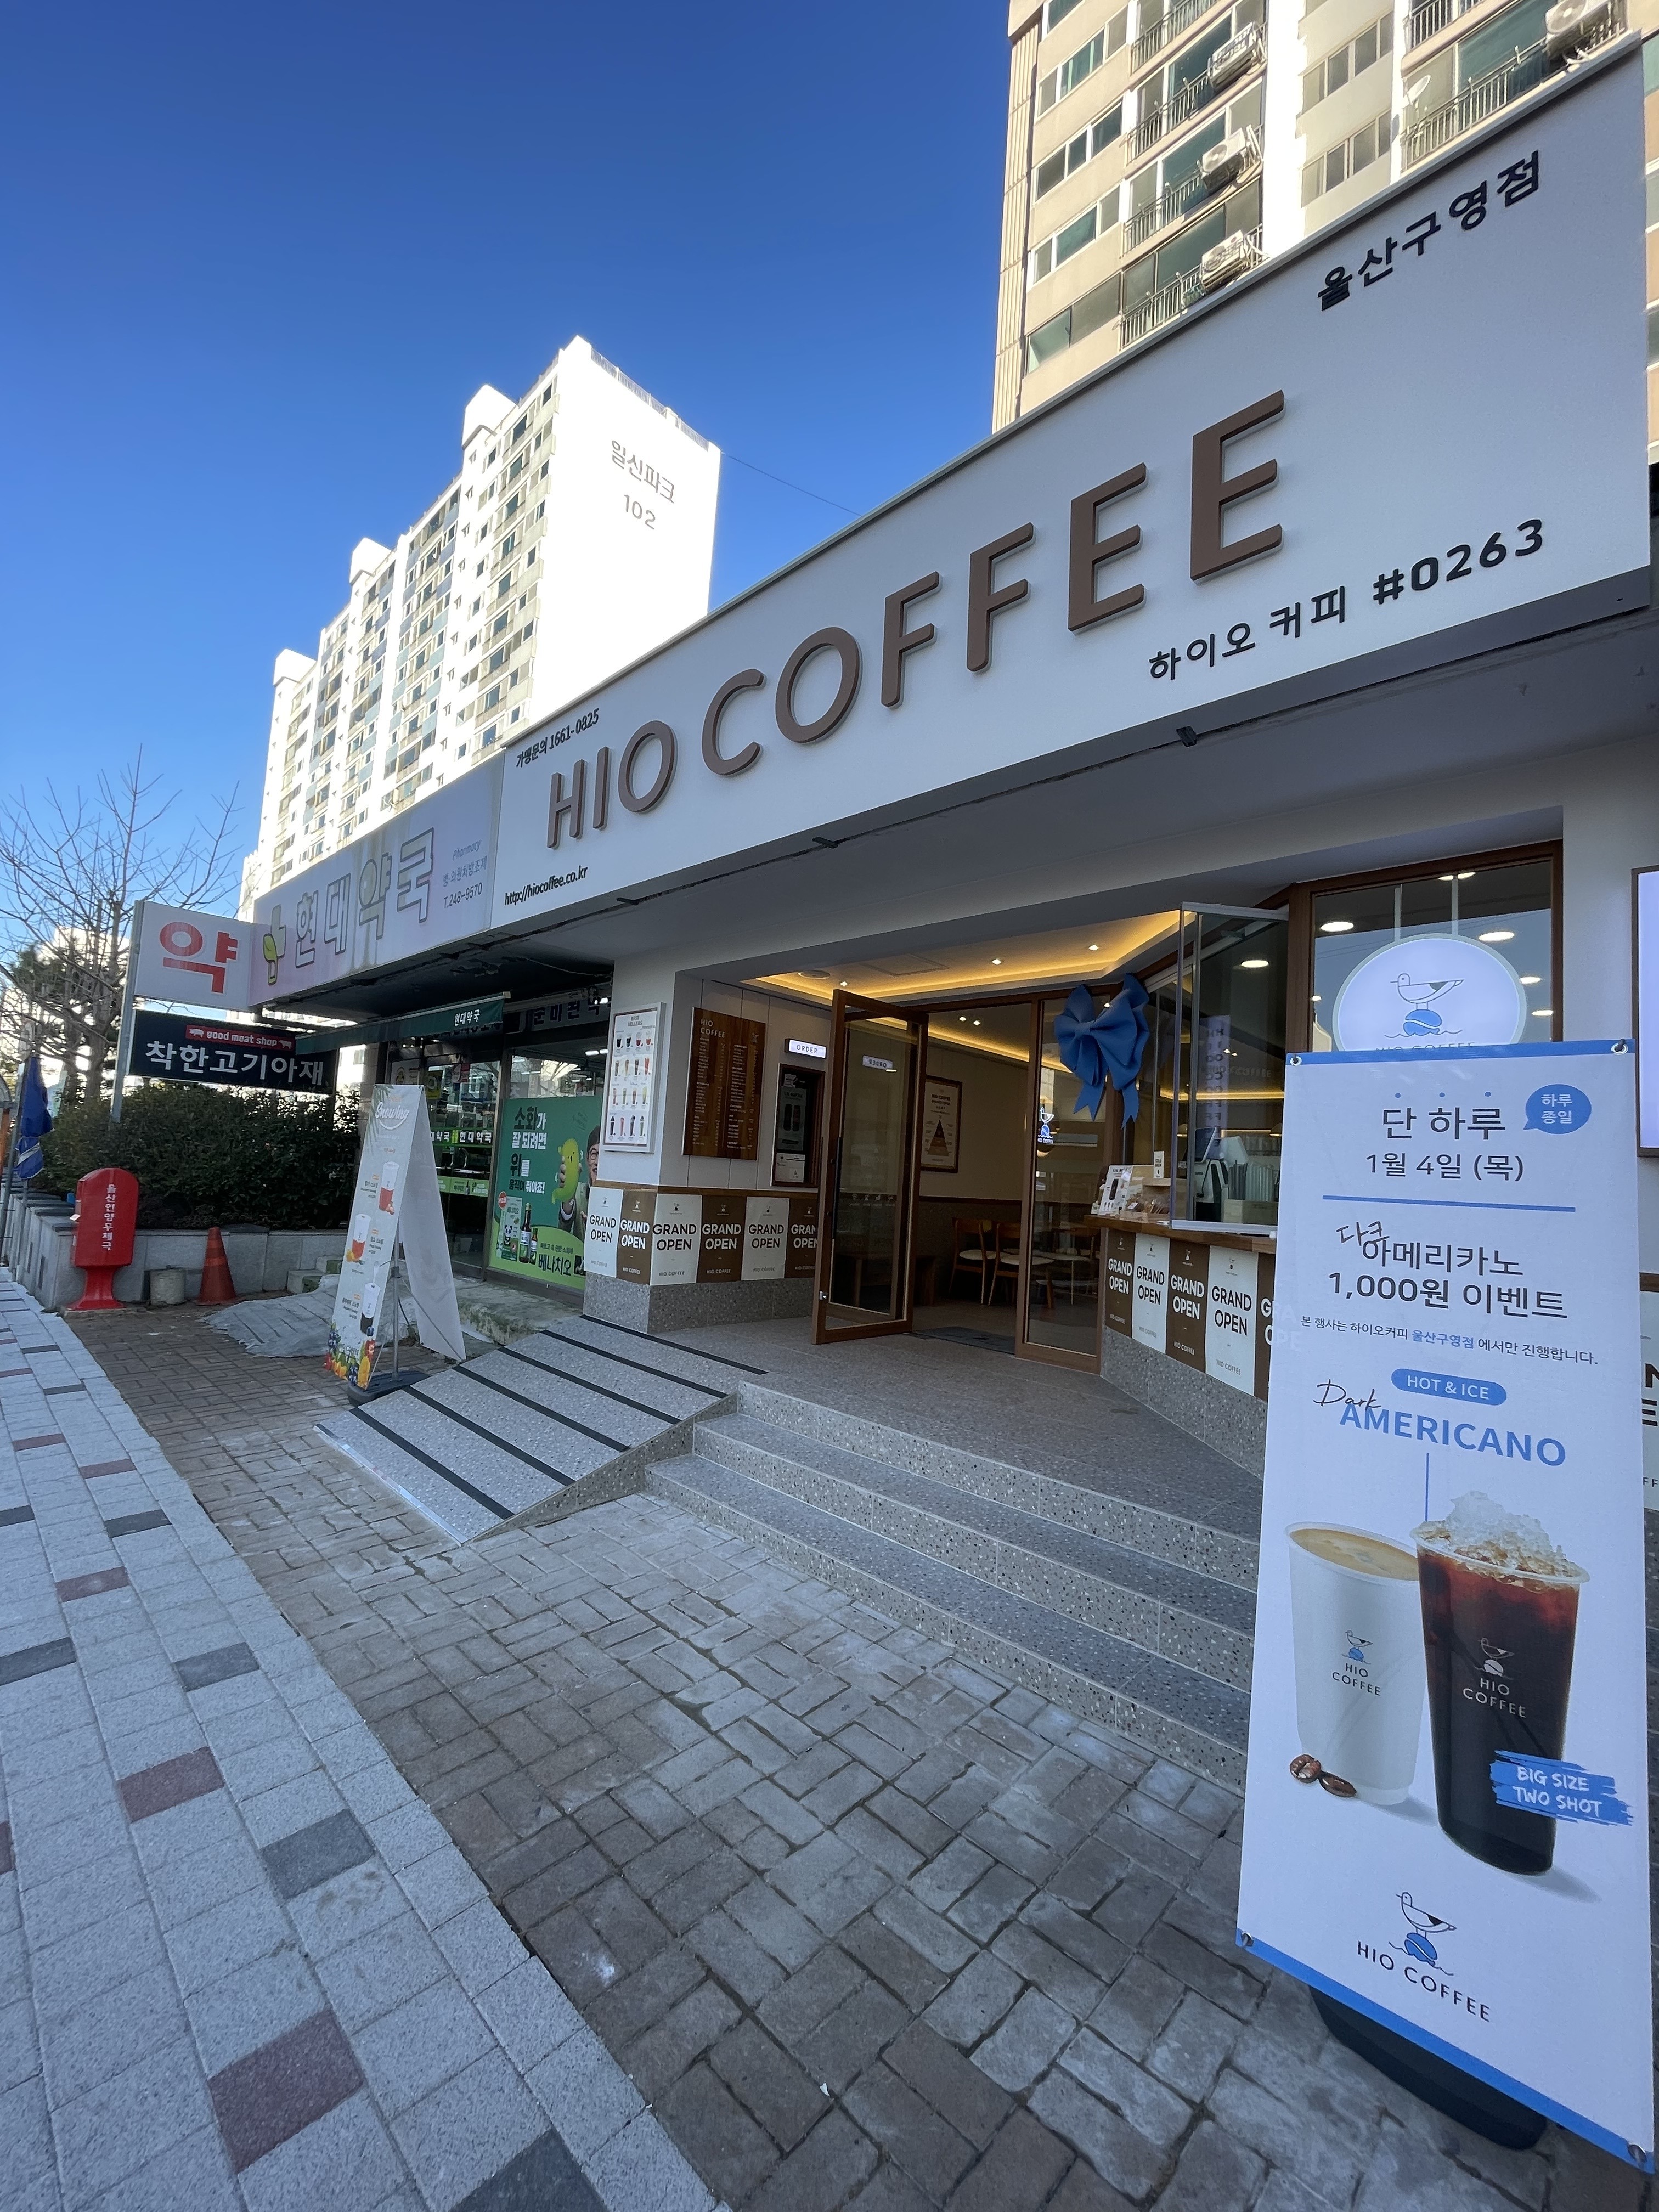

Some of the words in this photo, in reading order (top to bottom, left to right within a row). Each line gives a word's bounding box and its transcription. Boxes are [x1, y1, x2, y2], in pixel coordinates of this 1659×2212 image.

[1318, 149, 1539, 311] 울산구영점
[612, 440, 674, 504] 일신파크
[624, 494, 655, 529] 102
[1149, 623, 1255, 680] 하이오
[1269, 586, 1346, 637] 커피
[1372, 518, 1544, 605] #0263
[547, 720, 675, 849] HIO
[702, 389, 1284, 776] COFFEE
[516, 737, 548, 768] 가맹문의
[549, 708, 599, 750] 1661-0825
[443, 882, 483, 909] T.248-9570
[504, 865, 588, 905] http://hiocoffee.co.kr
[296, 827, 435, 968] 현대약국
[160, 922, 238, 994] 약
[454, 1009, 480, 1026] 현대약국
[206, 1031, 229, 1040] good
[232, 1034, 253, 1043] meat
[256, 1036, 277, 1046] shop
[701, 1028, 725, 1038] COFFEE
[797, 1045, 818, 1054] ORDER
[146, 1041, 324, 1086] 착한고기아재
[375, 1102, 409, 1120] Snowing
[1541, 1094, 1573, 1107] 하루
[514, 1106, 546, 1130] 소화가
[1383, 1107, 1417, 1139] 단
[1429, 1107, 1506, 1140] 하루
[1541, 1110, 1572, 1125] 종일
[460, 1130, 492, 1143] 현대약국
[512, 1132, 521, 1149] 잘
[522, 1132, 546, 1150] 되려면
[510, 1153, 530, 1177] 위를
[1366, 1153, 1406, 1177] 1월
[1415, 1154, 1461, 1179] 4일
[1474, 1154, 1523, 1181] (목)
[589, 1215, 616, 1228] GRAND
[620, 1218, 650, 1234] GRAND
[653, 1224, 697, 1234] GRAND
[702, 1223, 741, 1235] GRAND
[748, 1224, 784, 1234] GRAND
[791, 1224, 816, 1234] GRAN
[1336, 1221, 1390, 1246] 다크
[590, 1229, 612, 1243] OPEN
[621, 1234, 646, 1250] OPEN
[657, 1239, 692, 1250] OPEN
[705, 1238, 737, 1250] OPEN
[752, 1238, 780, 1249] OPEN
[538, 1254, 572, 1276] 베나치오
[1108, 1258, 1132, 1276] GRAND
[1362, 1239, 1523, 1276] 아메리카노
[1109, 1276, 1129, 1295] OPEN
[1136, 1265, 1165, 1285] GRAND
[1171, 1274, 1204, 1298] GRAND
[1138, 1285, 1161, 1305] OPEN
[1212, 1285, 1252, 1311] GRAND
[1328, 1272, 1449, 1310] 1,000원
[1463, 1284, 1567, 1318] 이벤트
[1173, 1296, 1200, 1320] OPEN
[1214, 1309, 1248, 1336] OPEN
[1301, 1316, 1312, 1327] 본
[1314, 1317, 1347, 1332] 행사는
[1350, 1322, 1408, 1340] 하이오커피
[1412, 1330, 1474, 1349] 울산구영점
[1478, 1339, 1519, 1355] 에서만
[1522, 1344, 1598, 1364] 진행합니다.
[1313, 1379, 1381, 1412] Dark
[1407, 1375, 1441, 1392] HOT
[1444, 1381, 1457, 1394] &
[1462, 1383, 1489, 1400] ICE
[1339, 1402, 1566, 1466] AMERICANO
[1345, 1663, 1369, 1678] HIO
[1331, 1671, 1381, 1696] COFFEE
[1479, 1677, 1510, 1696] HIO
[1463, 1686, 1527, 1719] COFFEE
[1517, 1766, 1548, 1786] BIG
[1551, 1773, 1590, 1792] SIZE
[1513, 1786, 1550, 1805] TWO
[1556, 1794, 1602, 1818] SHOT
[1357, 1940, 1394, 1971] HIO
[1404, 1966, 1491, 2023] COFFEE
